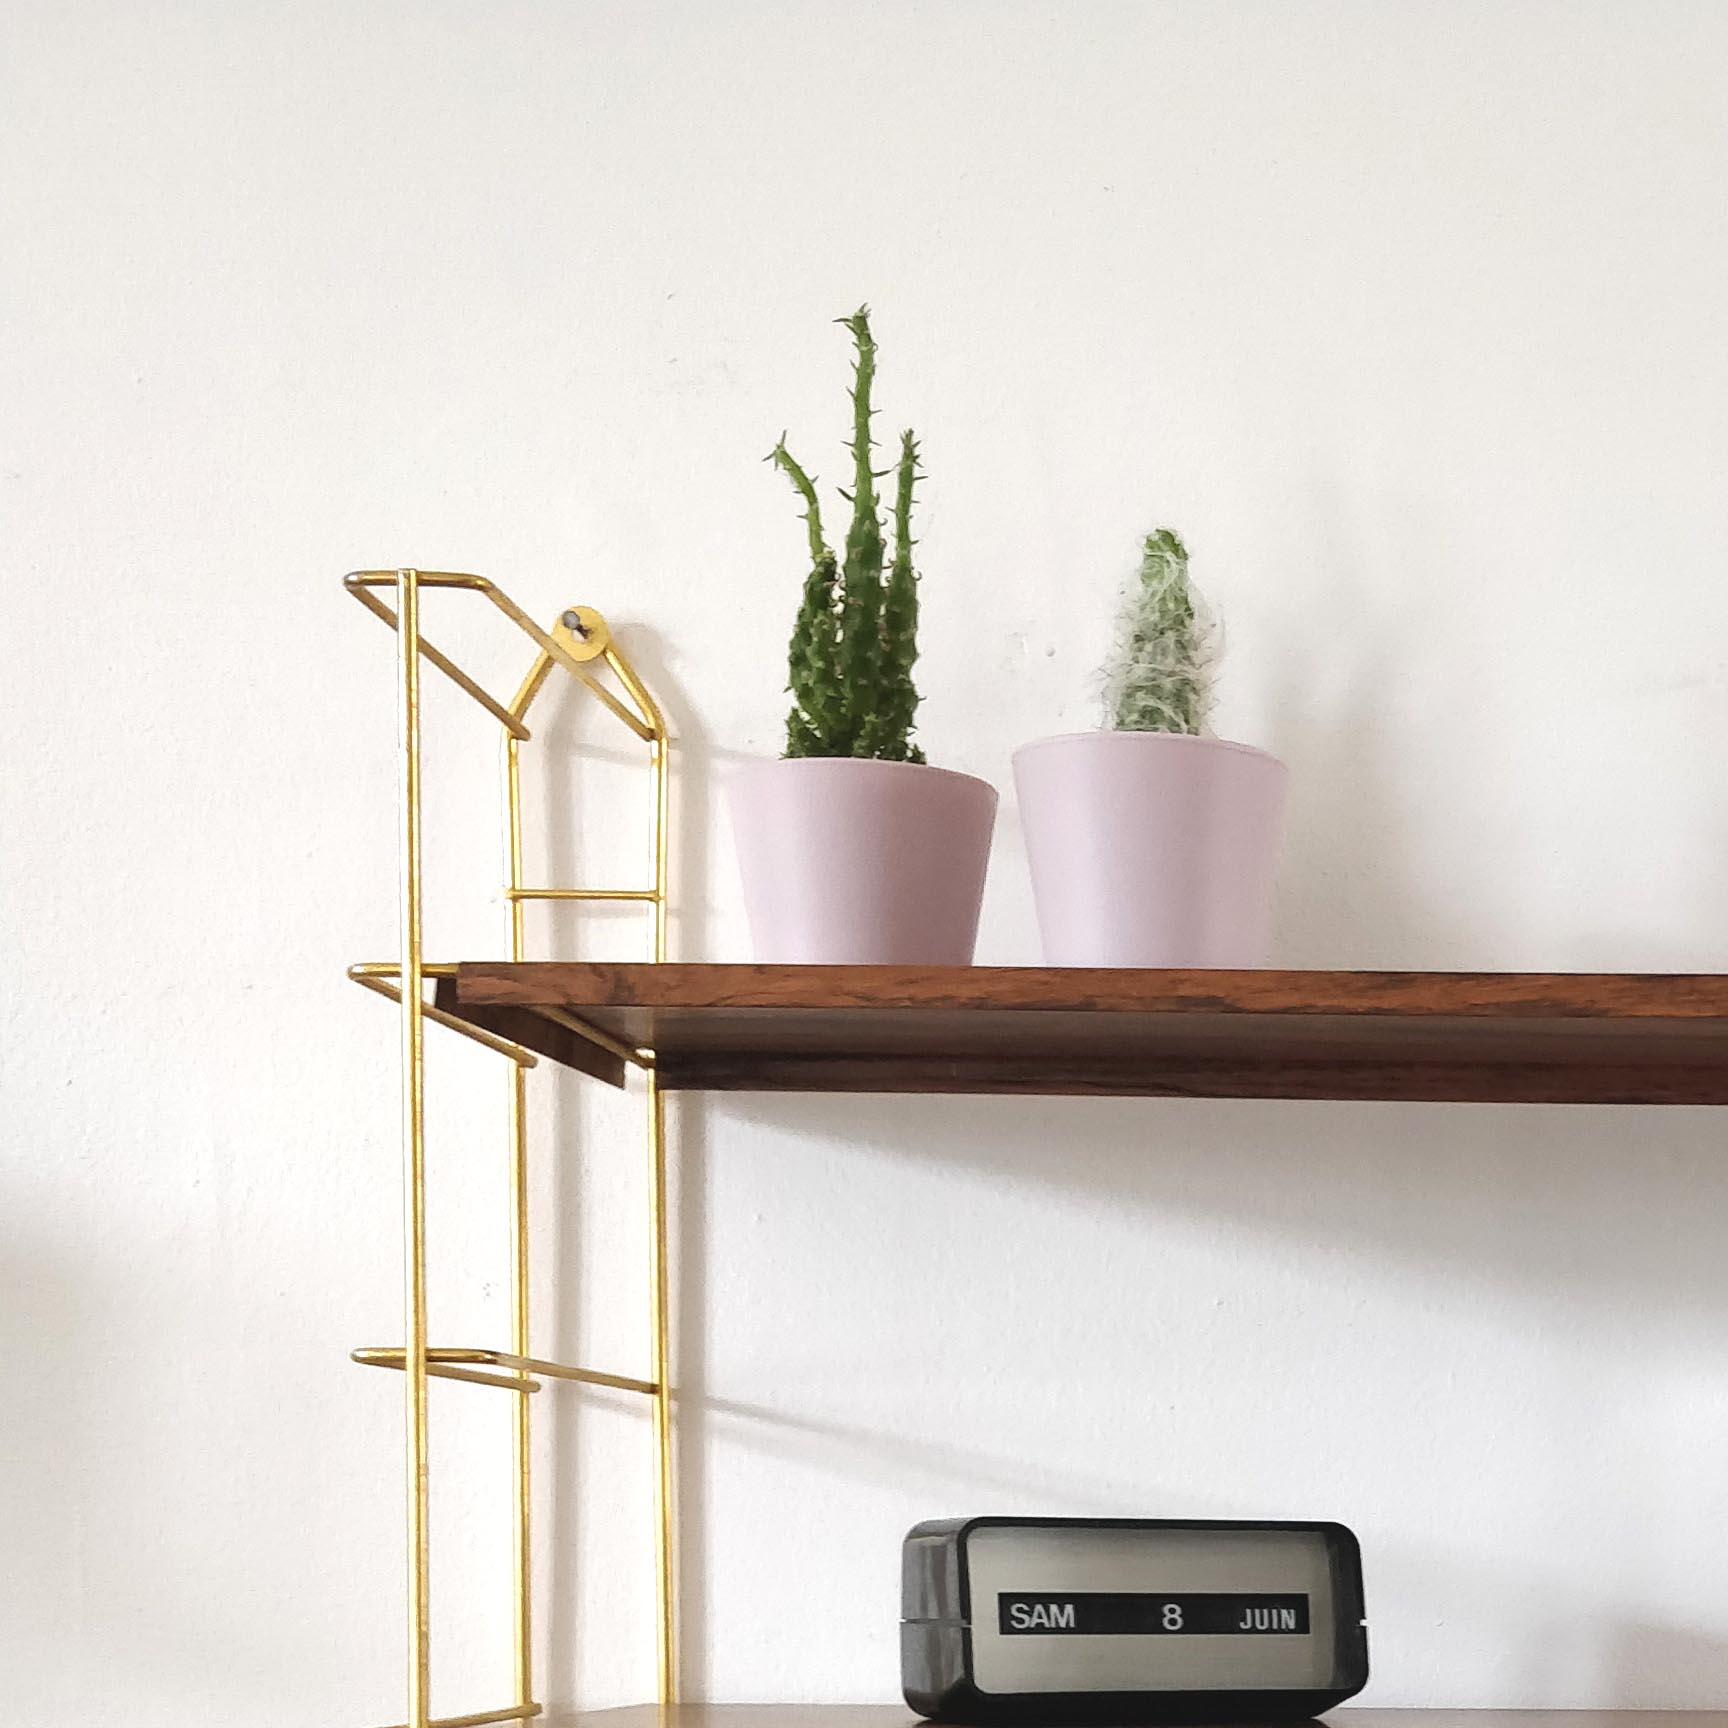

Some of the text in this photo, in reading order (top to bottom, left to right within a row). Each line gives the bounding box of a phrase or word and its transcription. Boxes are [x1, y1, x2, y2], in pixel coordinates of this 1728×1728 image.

[1010, 1603, 1296, 1631] SAM 8 JUIN
